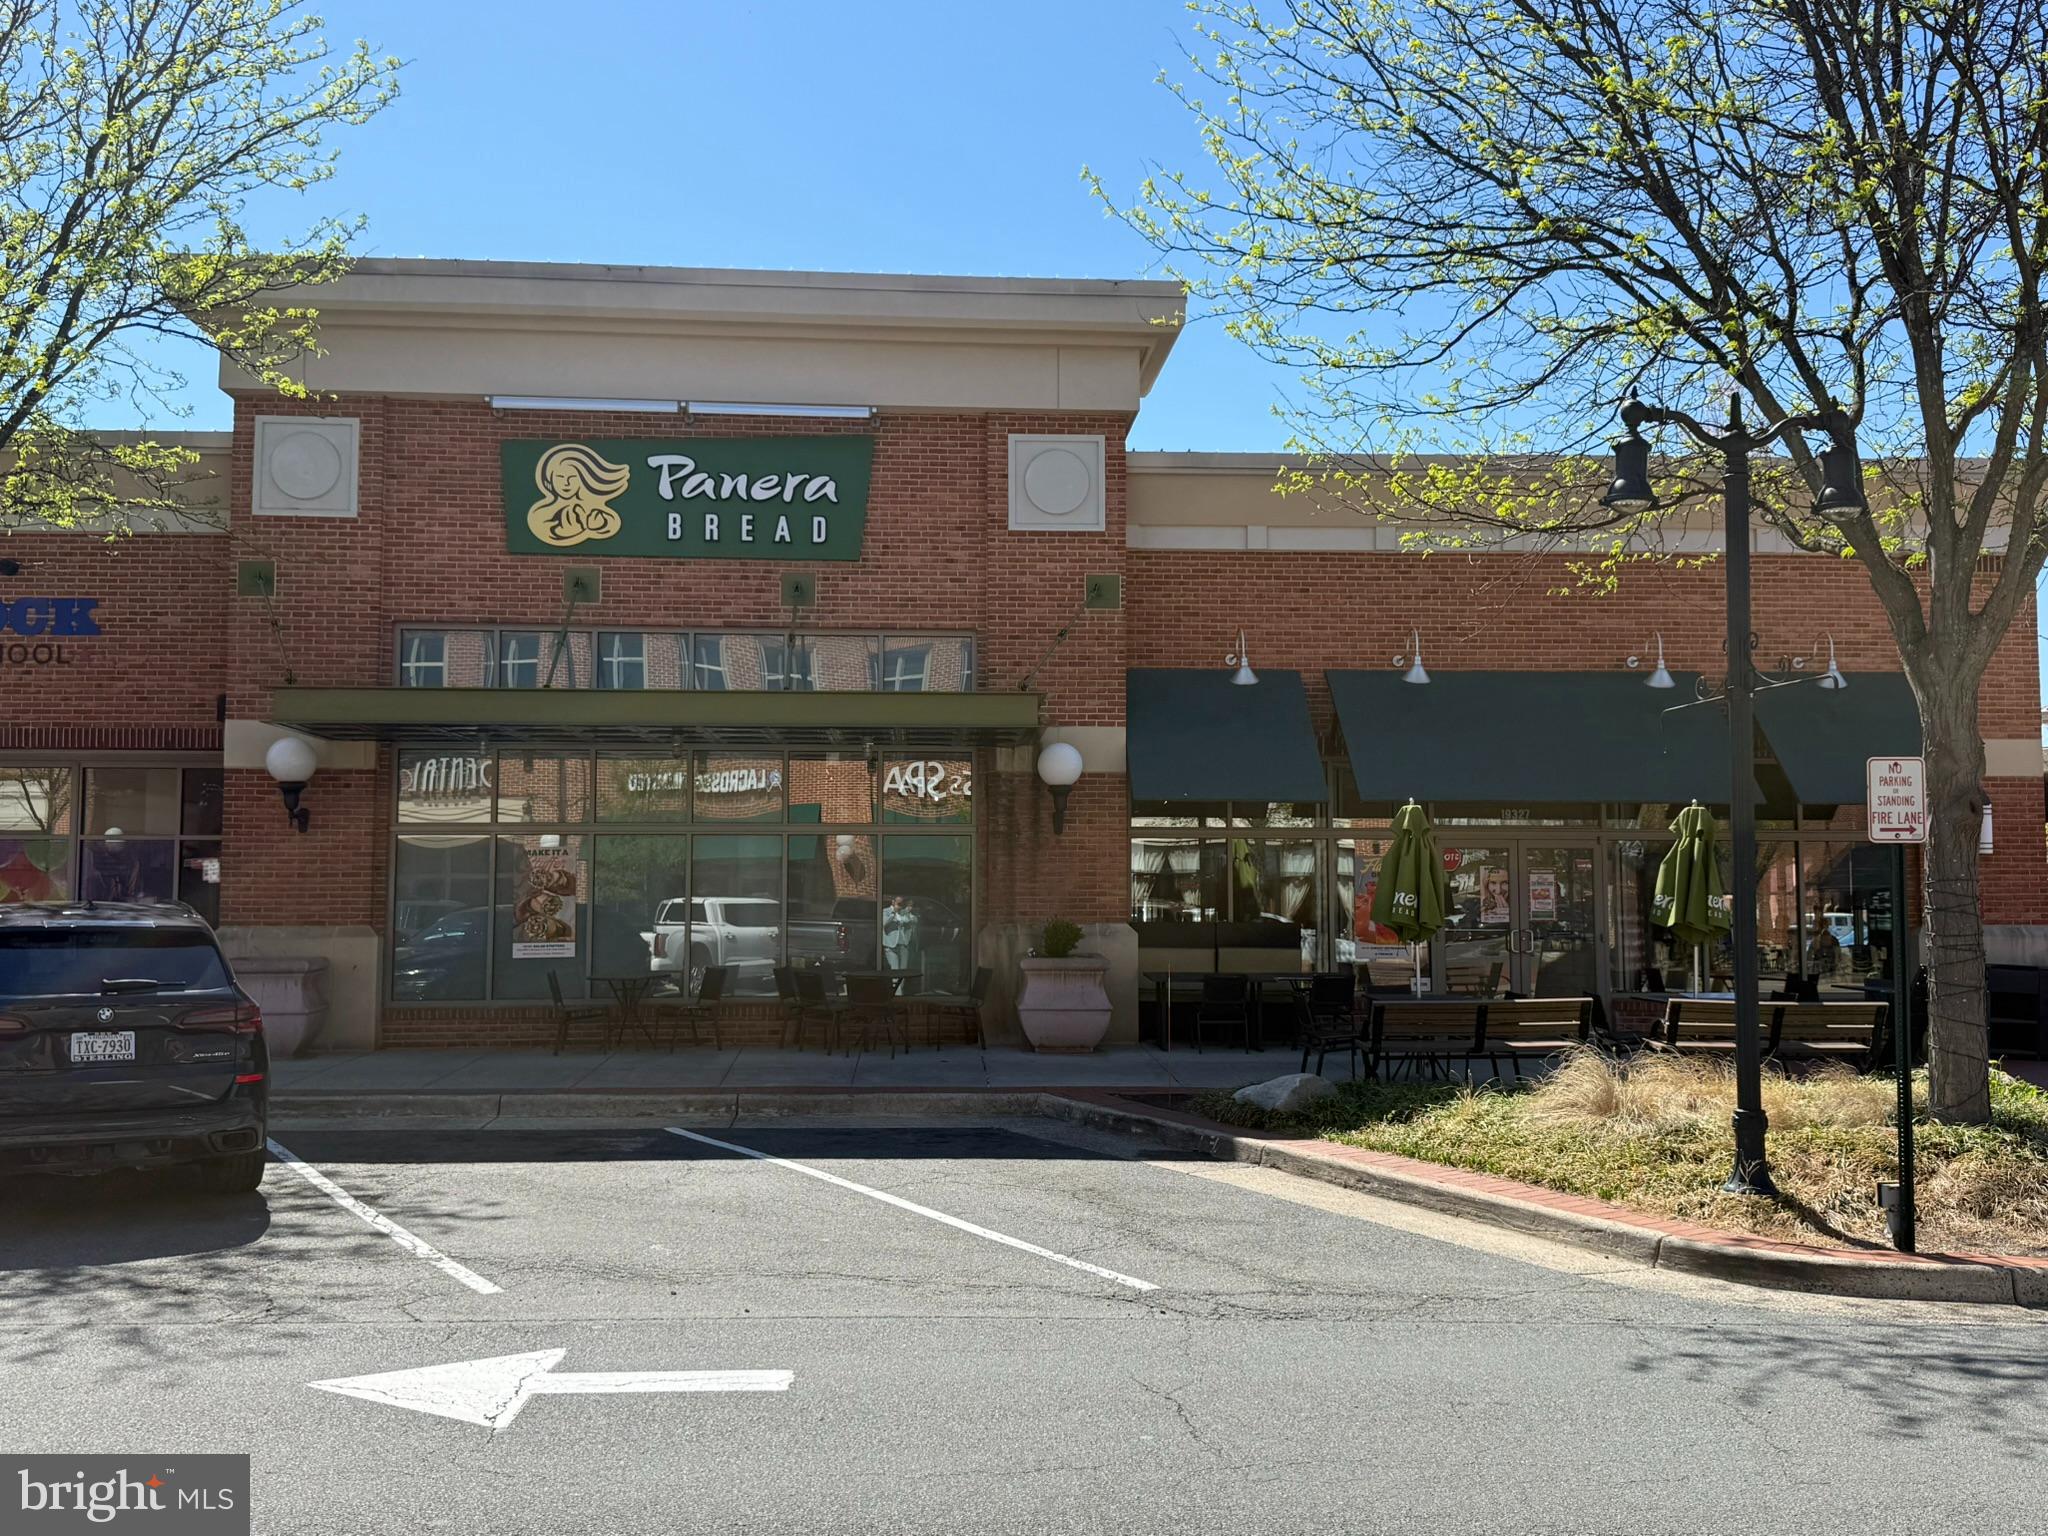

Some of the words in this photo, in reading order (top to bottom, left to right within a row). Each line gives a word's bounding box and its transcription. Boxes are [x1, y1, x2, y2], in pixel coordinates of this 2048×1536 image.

[647, 454, 838, 503] Panera
[667, 512, 827, 543] BREAD
[0, 643, 70, 664] OOL
[1888, 764, 1902, 774] NO
[1879, 776, 1912, 787] PARKING
[1877, 795, 1915, 807] STANDING
[1872, 811, 1893, 825] FIRE
[1897, 811, 1923, 825] LANE
[76, 1039, 131, 1054] TXC-7930
